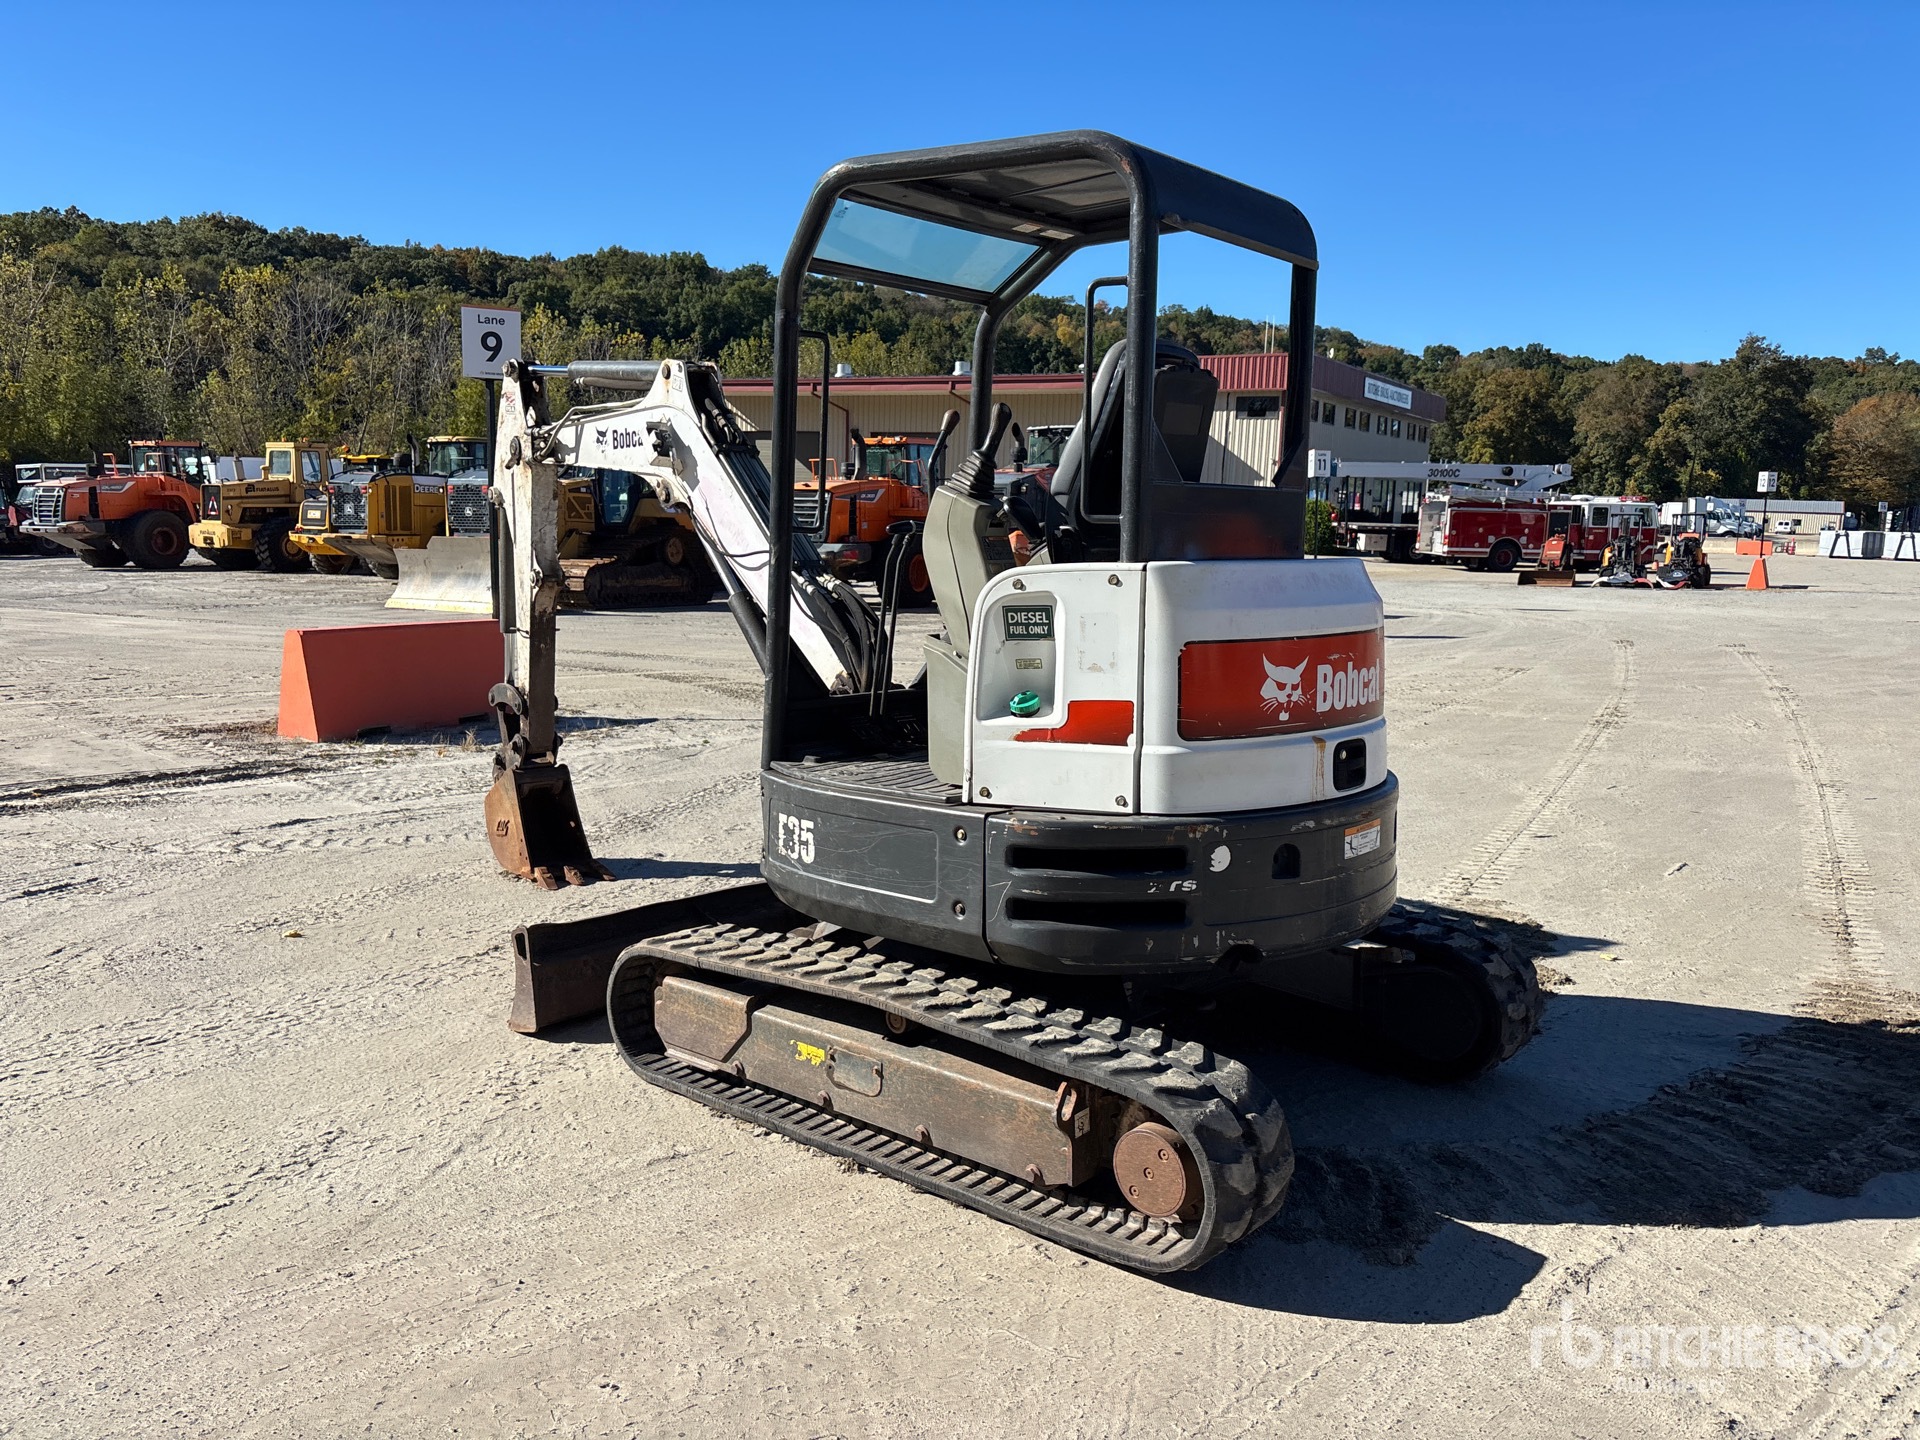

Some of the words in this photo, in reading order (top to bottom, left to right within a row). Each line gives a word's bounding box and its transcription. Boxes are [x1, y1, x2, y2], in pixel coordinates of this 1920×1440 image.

[477, 313, 506, 326] Lane
[480, 330, 503, 363] 9
[1317, 458, 1327, 471] 11
[1427, 468, 1461, 478] 30100C
[414, 484, 439, 494] DEERE
[1769, 478, 1776, 488] 12
[1007, 611, 1050, 624] DIESEL
[1009, 625, 1028, 635] FUEL
[1028, 625, 1050, 635] ONLY
[1315, 657, 1381, 713] Bobcat
